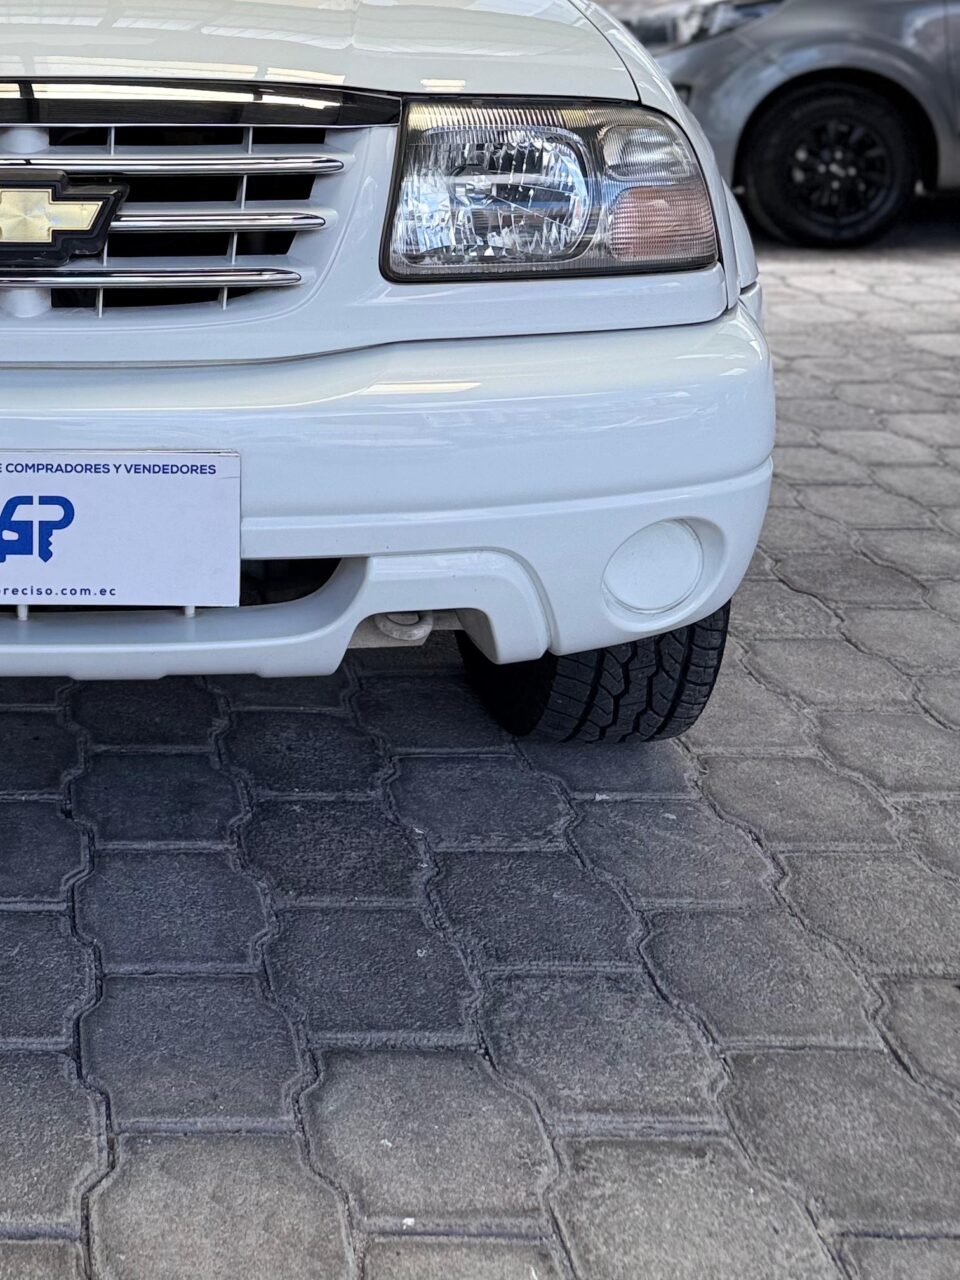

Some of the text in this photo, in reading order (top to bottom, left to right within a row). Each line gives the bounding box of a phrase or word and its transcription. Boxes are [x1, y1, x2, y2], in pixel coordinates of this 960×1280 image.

[5, 463, 111, 474] COMPRADORES
[112, 464, 123, 473] Y
[124, 464, 217, 475] VENDEDORES
